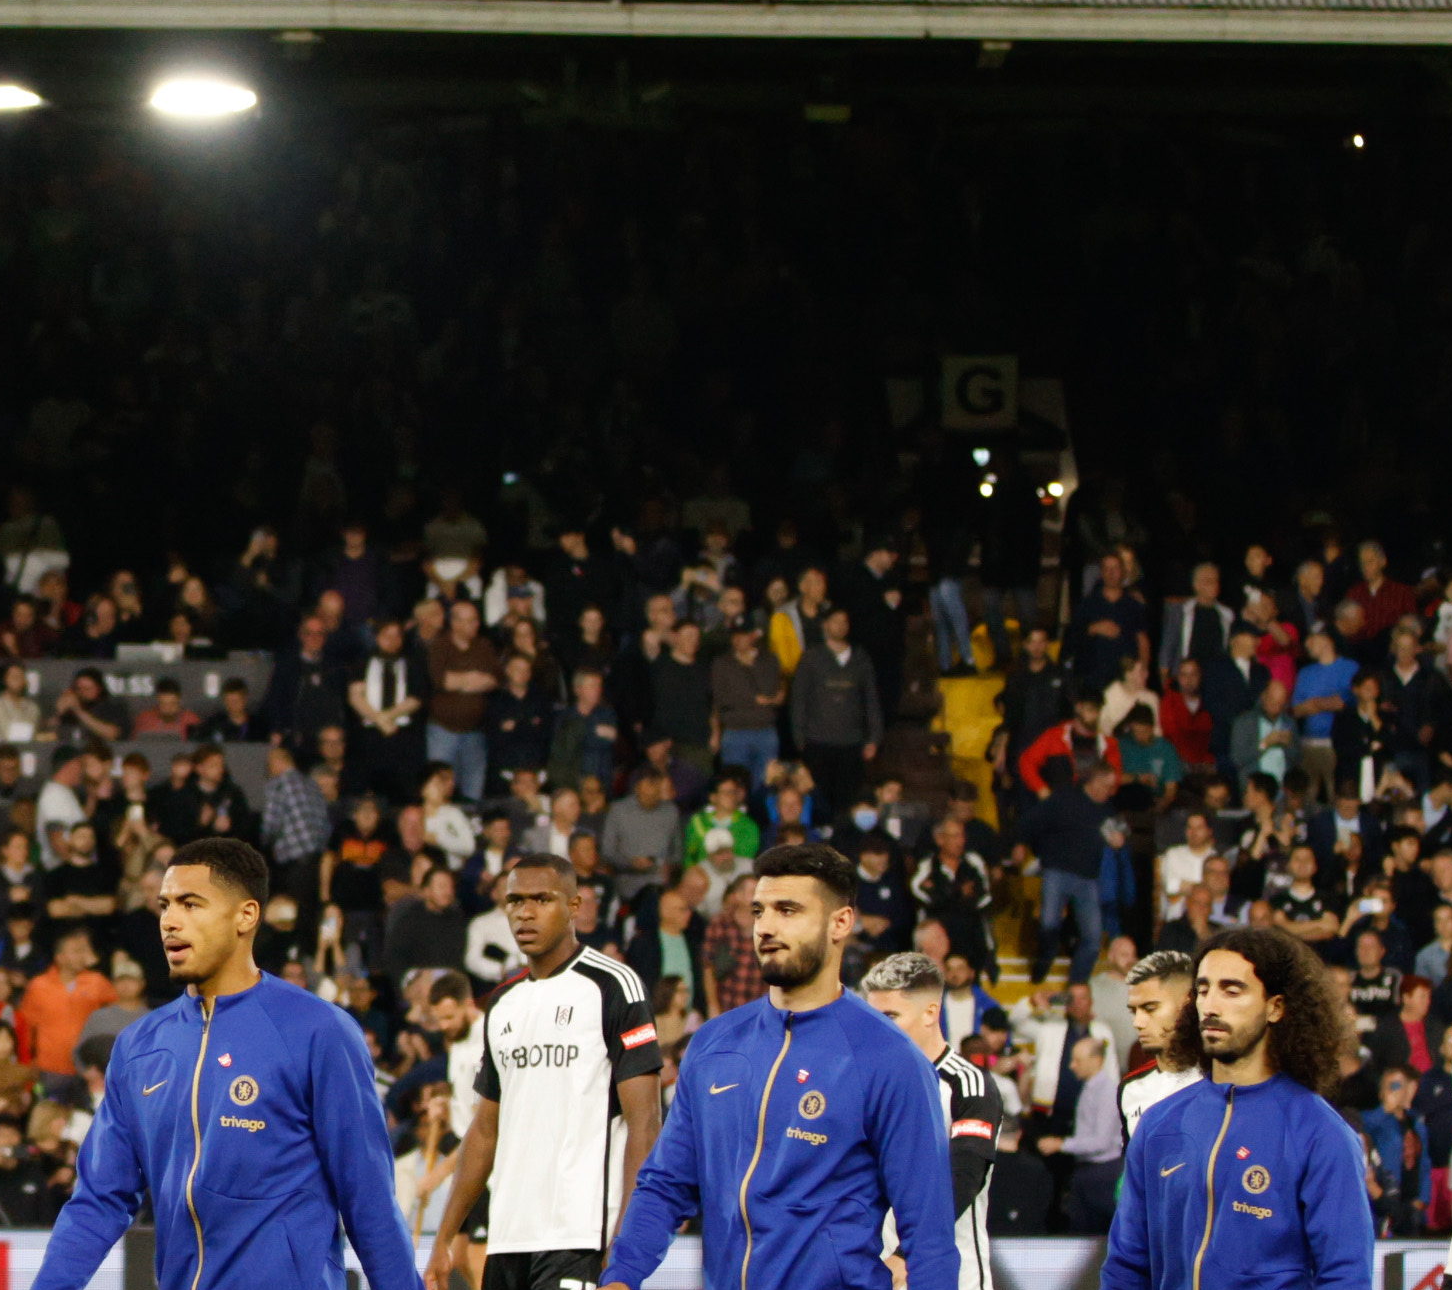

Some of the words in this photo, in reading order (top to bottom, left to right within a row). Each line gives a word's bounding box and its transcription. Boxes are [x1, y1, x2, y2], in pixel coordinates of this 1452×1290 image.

[957, 366, 1004, 416] G
[220, 1115, 266, 1133] trivago
[786, 1127, 828, 1146] trivago
[1232, 1200, 1273, 1220] trivago
